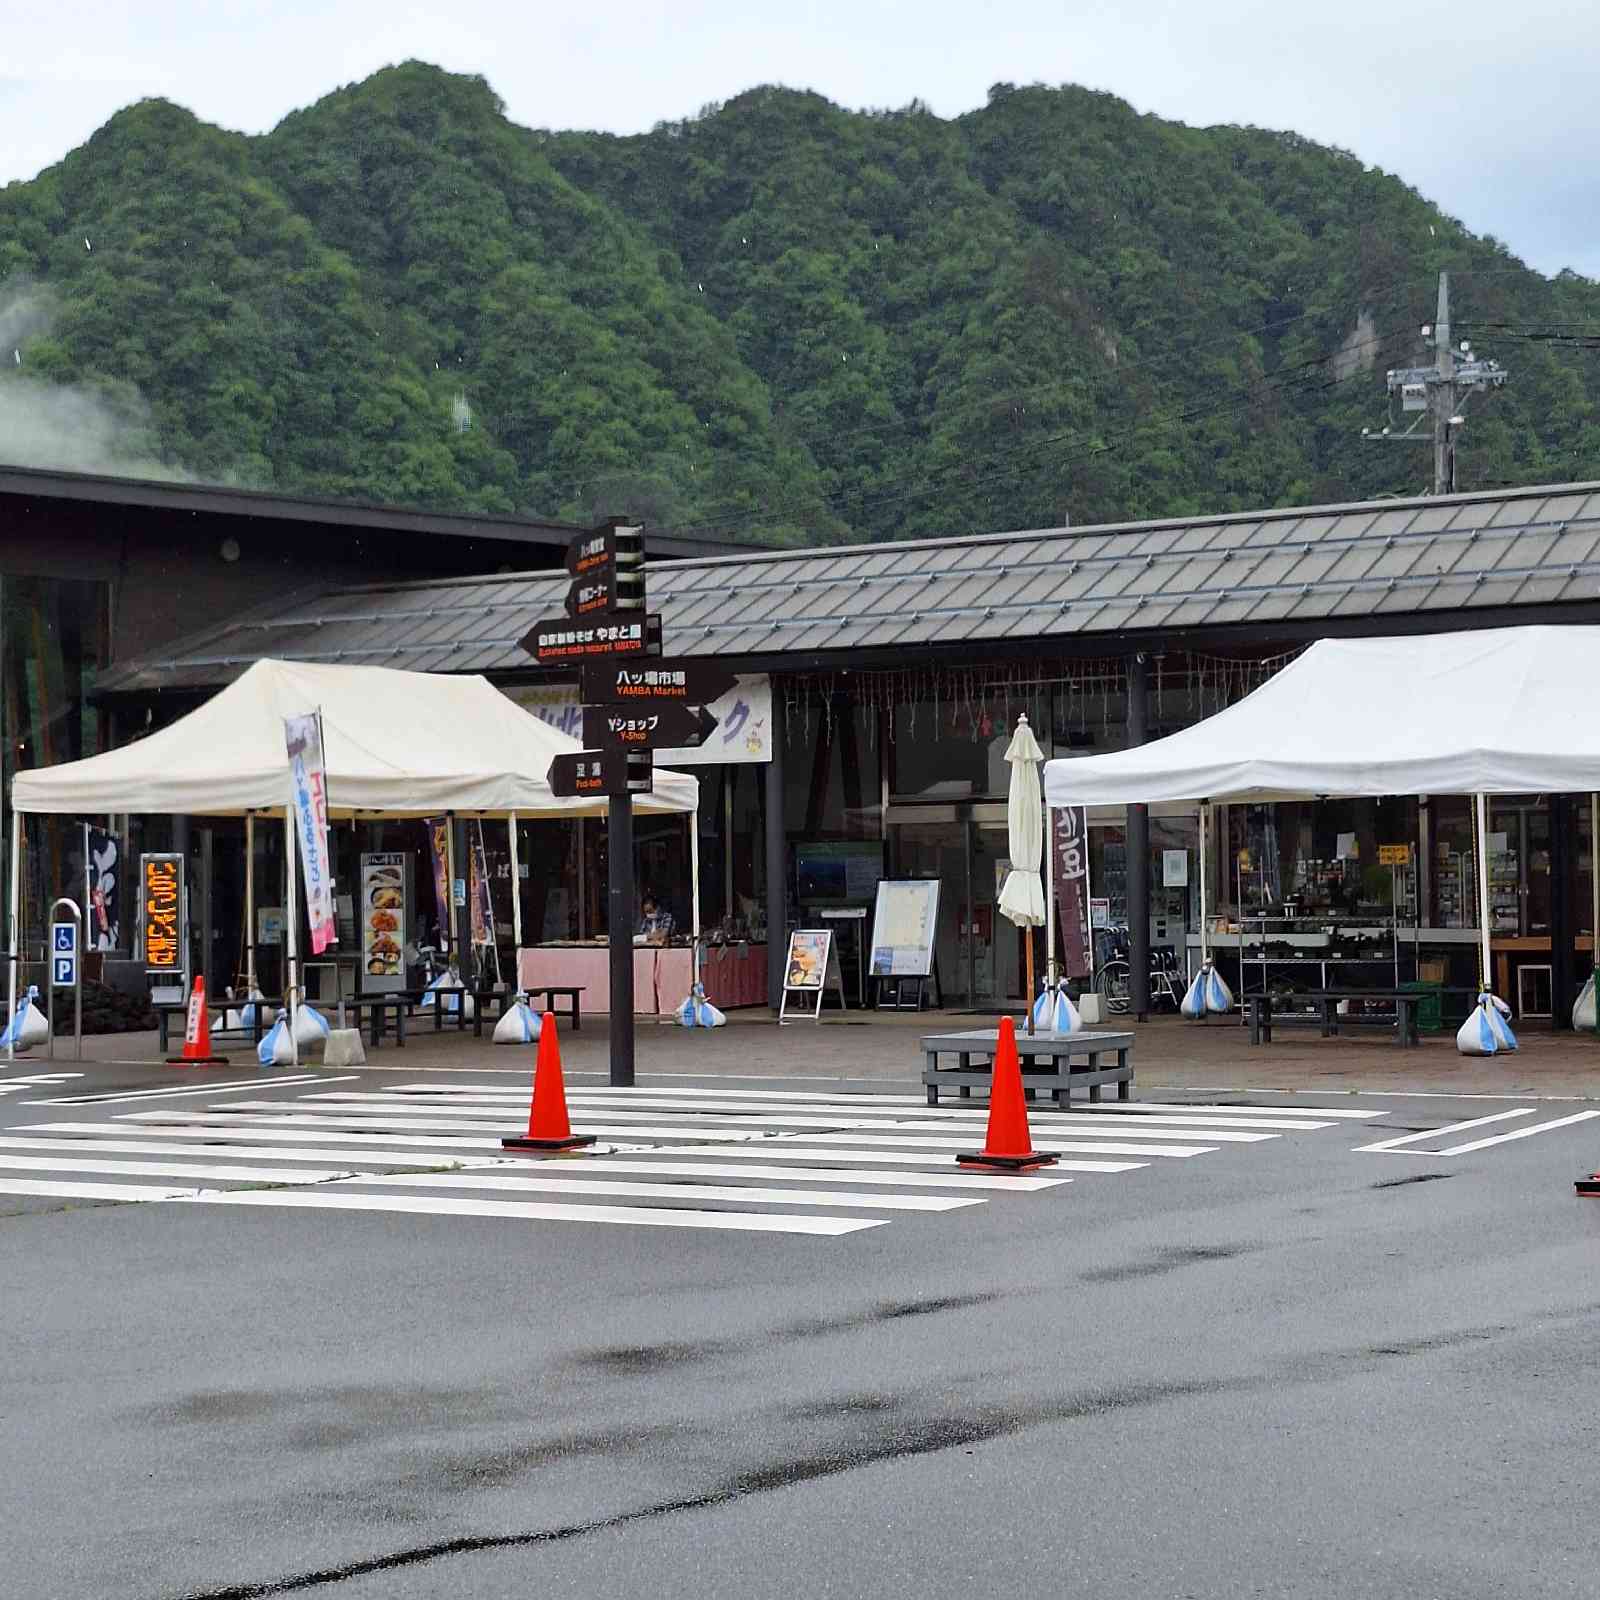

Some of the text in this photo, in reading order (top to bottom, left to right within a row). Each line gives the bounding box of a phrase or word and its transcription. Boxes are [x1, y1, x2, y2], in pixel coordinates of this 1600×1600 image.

[616, 670, 686, 686] 八ッ場市場
[616, 686, 686, 696] YAMBA Market
[607, 714, 659, 731] Yショップ
[620, 731, 647, 741] Y-Shop
[58, 960, 71, 980] P
